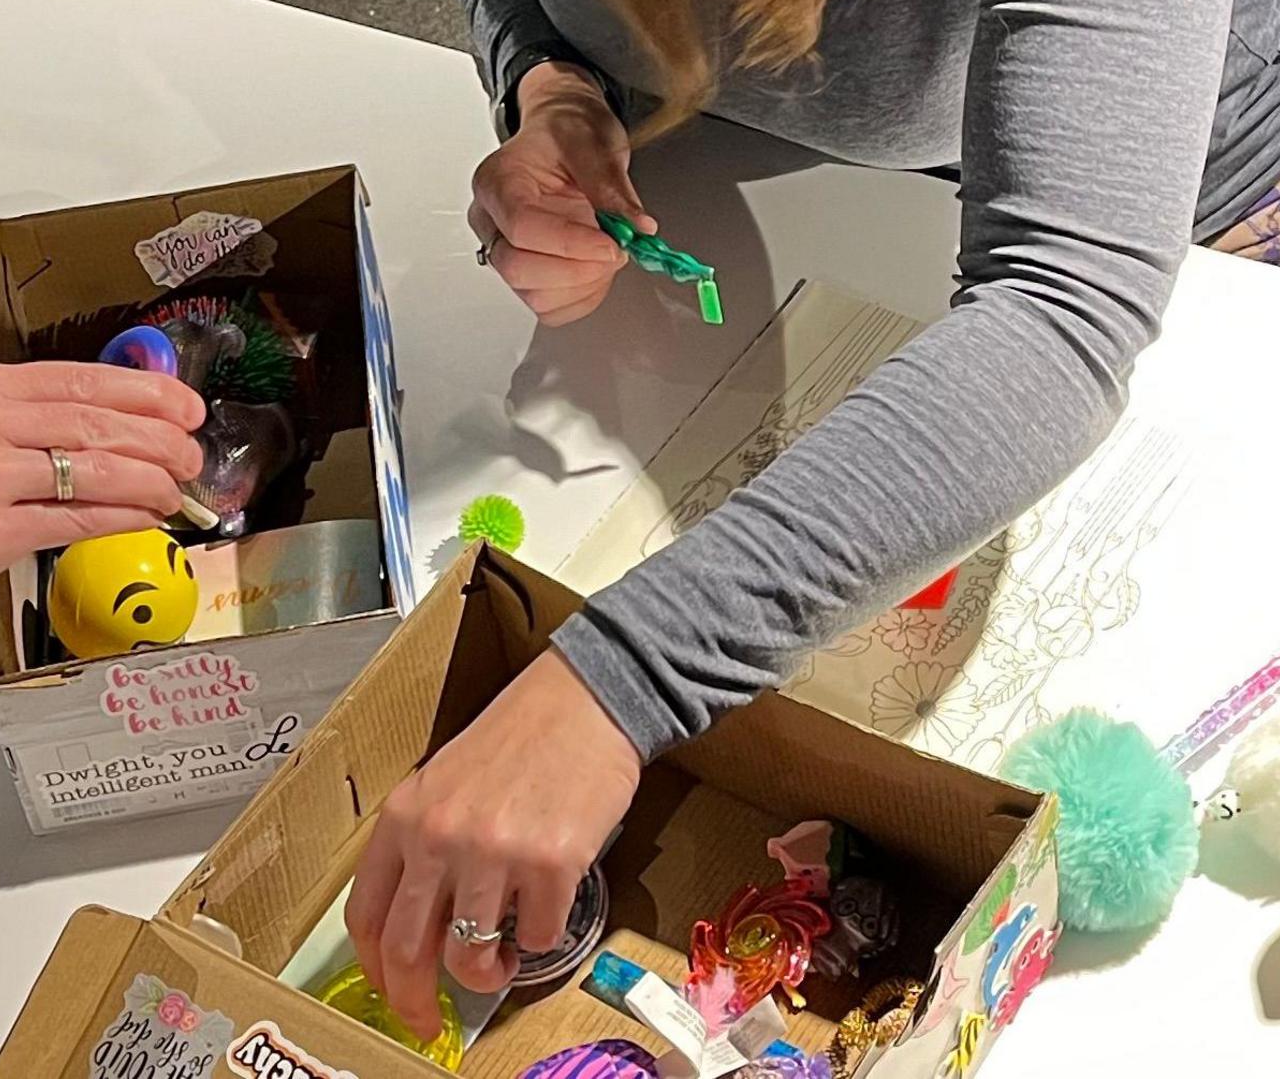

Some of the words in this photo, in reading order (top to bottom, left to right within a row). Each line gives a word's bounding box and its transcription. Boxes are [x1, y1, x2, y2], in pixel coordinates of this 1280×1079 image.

[155, 234, 198, 268] you
[205, 223, 239, 242] can
[183, 252, 205, 270] do
[112, 667, 149, 687] be
[160, 656, 235, 682] silly
[106, 692, 144, 713] be
[150, 675, 255, 705] honest
[128, 713, 167, 734] be
[171, 697, 248, 726] kind
[44, 755, 164, 788] Dwight,
[171, 745, 227, 768] you
[50, 770, 182, 805] intelligent
[190, 760, 255, 780] man.
[107, 1011, 152, 1050] did
[154, 1032, 189, 1068] she
[188, 1054, 213, 1076] so
